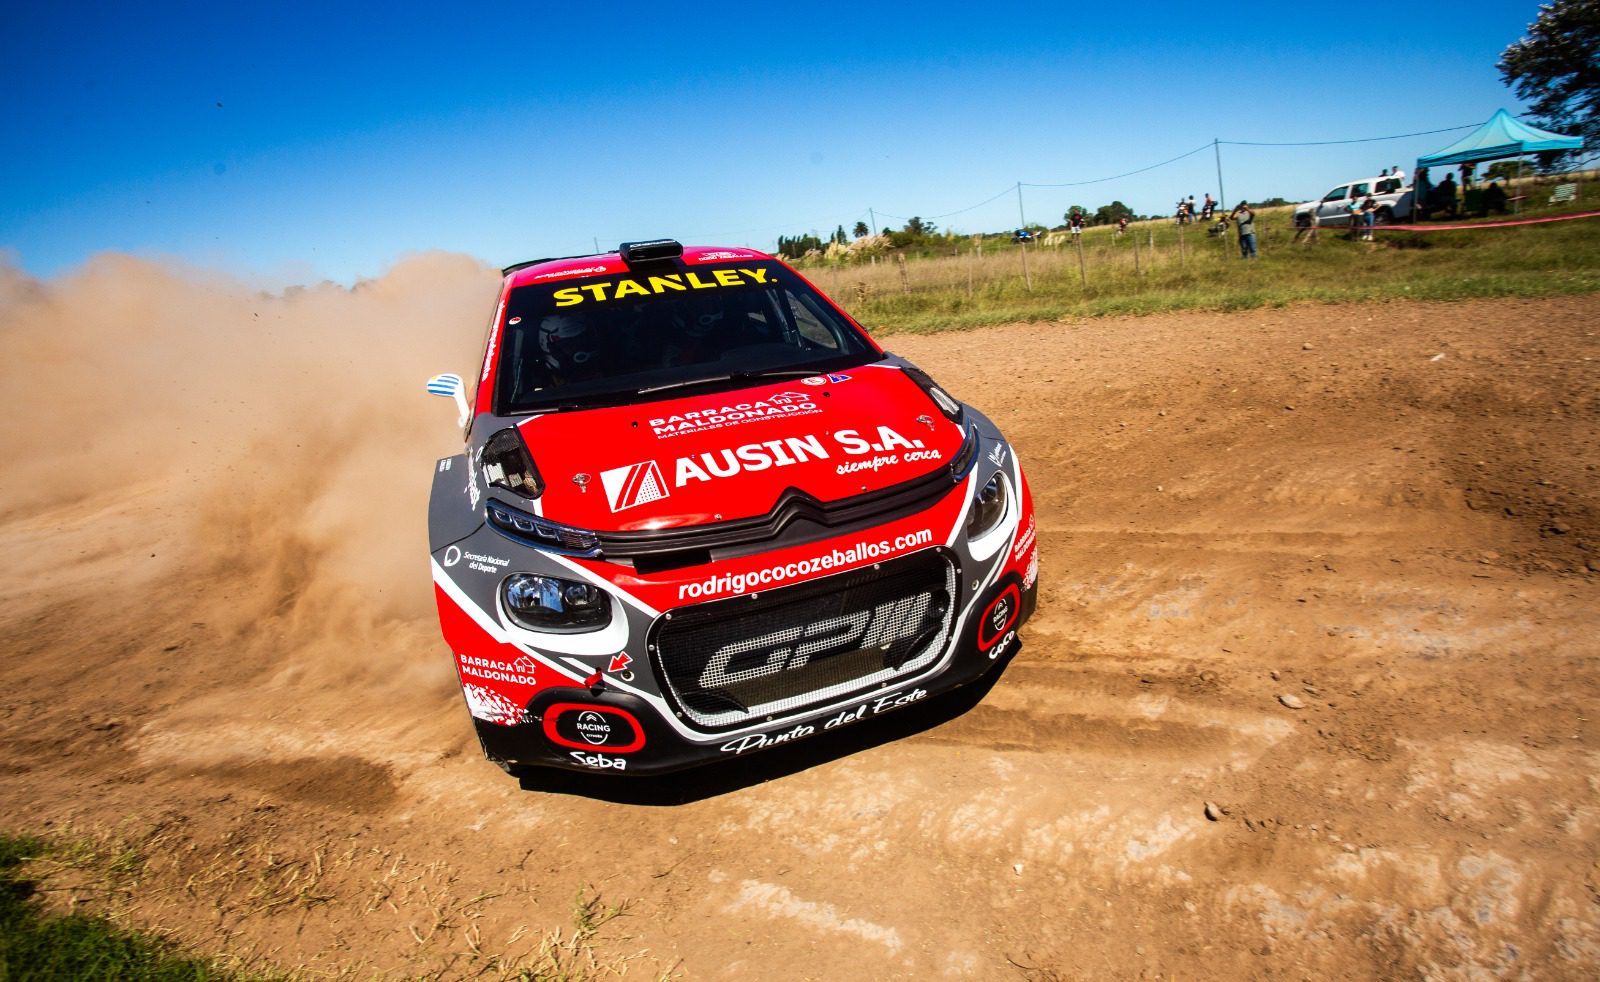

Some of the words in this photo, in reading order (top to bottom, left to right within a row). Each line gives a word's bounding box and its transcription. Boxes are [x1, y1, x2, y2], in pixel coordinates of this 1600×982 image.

[649, 401, 771, 427] BARRACA
[653, 402, 817, 435] MALDONADO
[657, 424, 724, 439] MATERIALES
[725, 420, 740, 428] DE
[675, 435, 830, 487] AUSIN
[833, 425, 925, 455] S.A.
[836, 454, 899, 475] siempre
[903, 449, 942, 462] cerca
[469, 561, 479, 570] del
[478, 563, 498, 574] Deporte
[487, 556, 511, 567] Nacional
[678, 528, 933, 599] rodrigococozeballos.com
[460, 653, 514, 672] BARRACA
[462, 664, 537, 686] MALDONADO
[576, 722, 611, 732] RACING
[720, 724, 815, 754] Punta
[824, 704, 867, 730] del
[872, 688, 928, 714] Este
[569, 751, 626, 771] Seba
